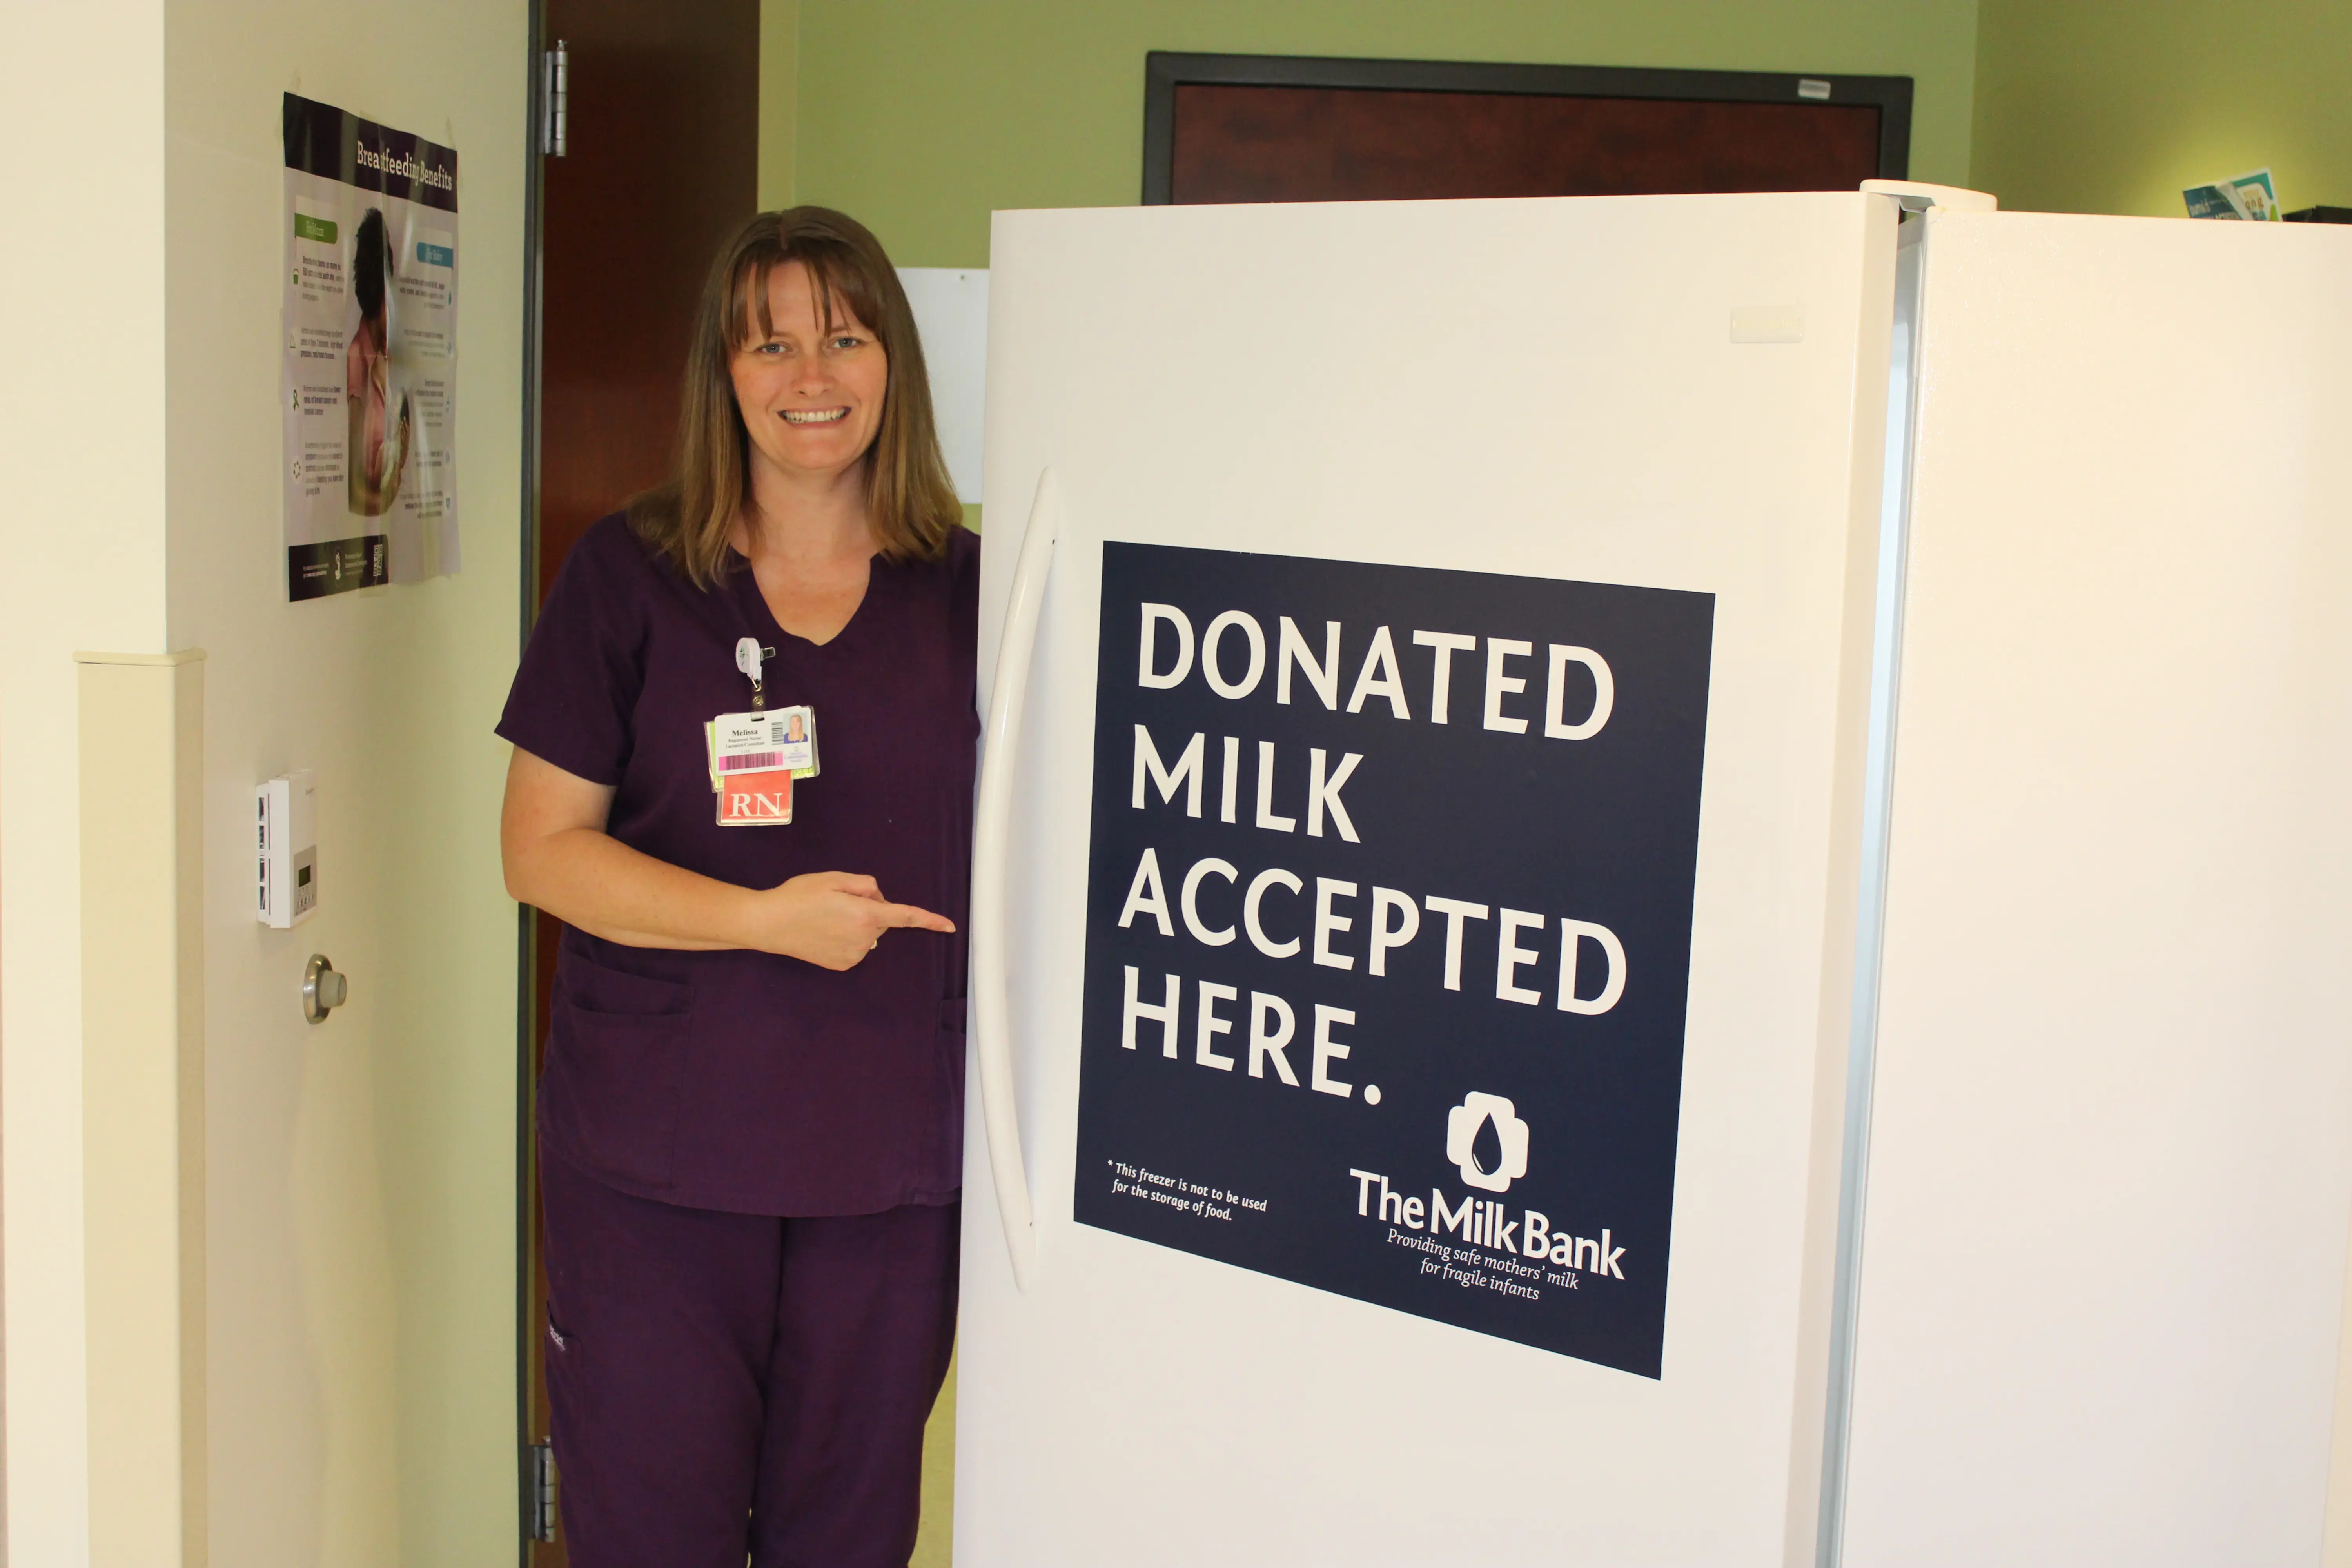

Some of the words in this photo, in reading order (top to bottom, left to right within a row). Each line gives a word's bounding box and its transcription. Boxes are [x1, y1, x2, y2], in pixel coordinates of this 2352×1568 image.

[358, 140, 419, 186] Breastfeeding
[420, 160, 452, 191] Benefits
[1139, 603, 1614, 740] DONATED
[729, 793, 783, 817] RN
[1132, 724, 1363, 843] MILK
[1118, 848, 1626, 1015] ACCEPTED
[1122, 965, 1381, 1105] HERE.
[1111, 1178, 1129, 1194] for
[1131, 1184, 1148, 1199] the
[1151, 1191, 1190, 1211] storage
[1192, 1201, 1205, 1216] of
[1204, 1203, 1232, 1221] food.
[1116, 1162, 1137, 1178] This
[1138, 1168, 1176, 1187] freezer
[1178, 1178, 1187, 1191] is
[1190, 1184, 1209, 1197] not
[1211, 1188, 1223, 1200] to
[1226, 1190, 1239, 1205] be
[1241, 1198, 1267, 1212] used
[1350, 1168, 1424, 1229] The
[1430, 1188, 1519, 1254] Milk
[1523, 1210, 1627, 1280] Bank
[1387, 1228, 1452, 1261] Providing
[1453, 1249, 1481, 1266] safe
[1484, 1257, 1545, 1279] mothers'
[1547, 1272, 1579, 1289] milk
[1420, 1257, 1441, 1274] for
[1443, 1263, 1487, 1287] fragile
[1490, 1275, 1540, 1300] infants
